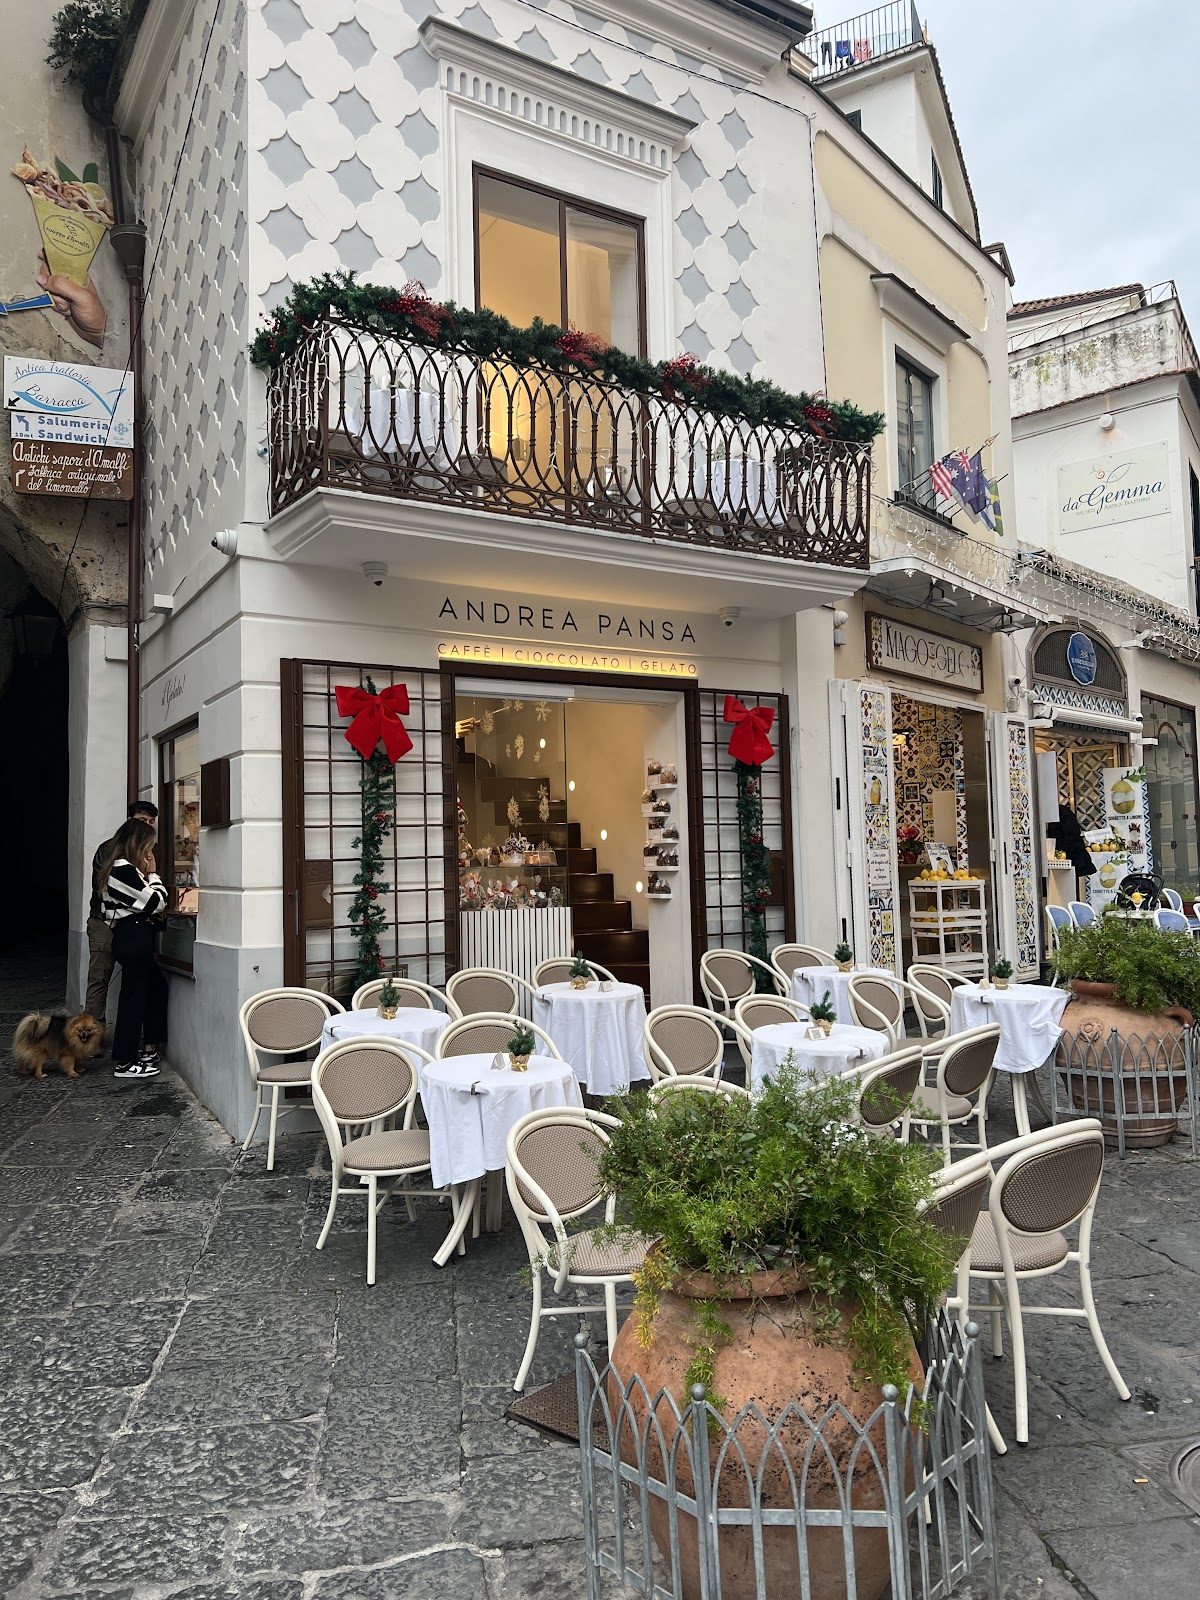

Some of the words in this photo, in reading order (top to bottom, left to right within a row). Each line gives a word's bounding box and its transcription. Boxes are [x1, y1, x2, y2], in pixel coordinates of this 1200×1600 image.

[14, 364, 46, 378] Antica
[49, 362, 92, 386] Trattoria
[25, 384, 85, 407] Barracca
[38, 415, 109, 430] Salumeria
[38, 429, 106, 444] Sandwich
[12, 441, 51, 464] Antichi
[52, 450, 83, 470] sapori
[28, 465, 62, 479] Fabbrica
[68, 468, 116, 483] artigianale
[28, 477, 42, 491] del
[45, 480, 92, 494] limoncello
[1062, 497, 1081, 513] da
[1078, 480, 1166, 515] Gemma
[438, 596, 579, 632] ANDREA
[598, 614, 696, 644] PANSA
[437, 643, 491, 658] CAFFÈ
[514, 649, 621, 670] CIOCCOLATO
[640, 660, 698, 675] GELATO
